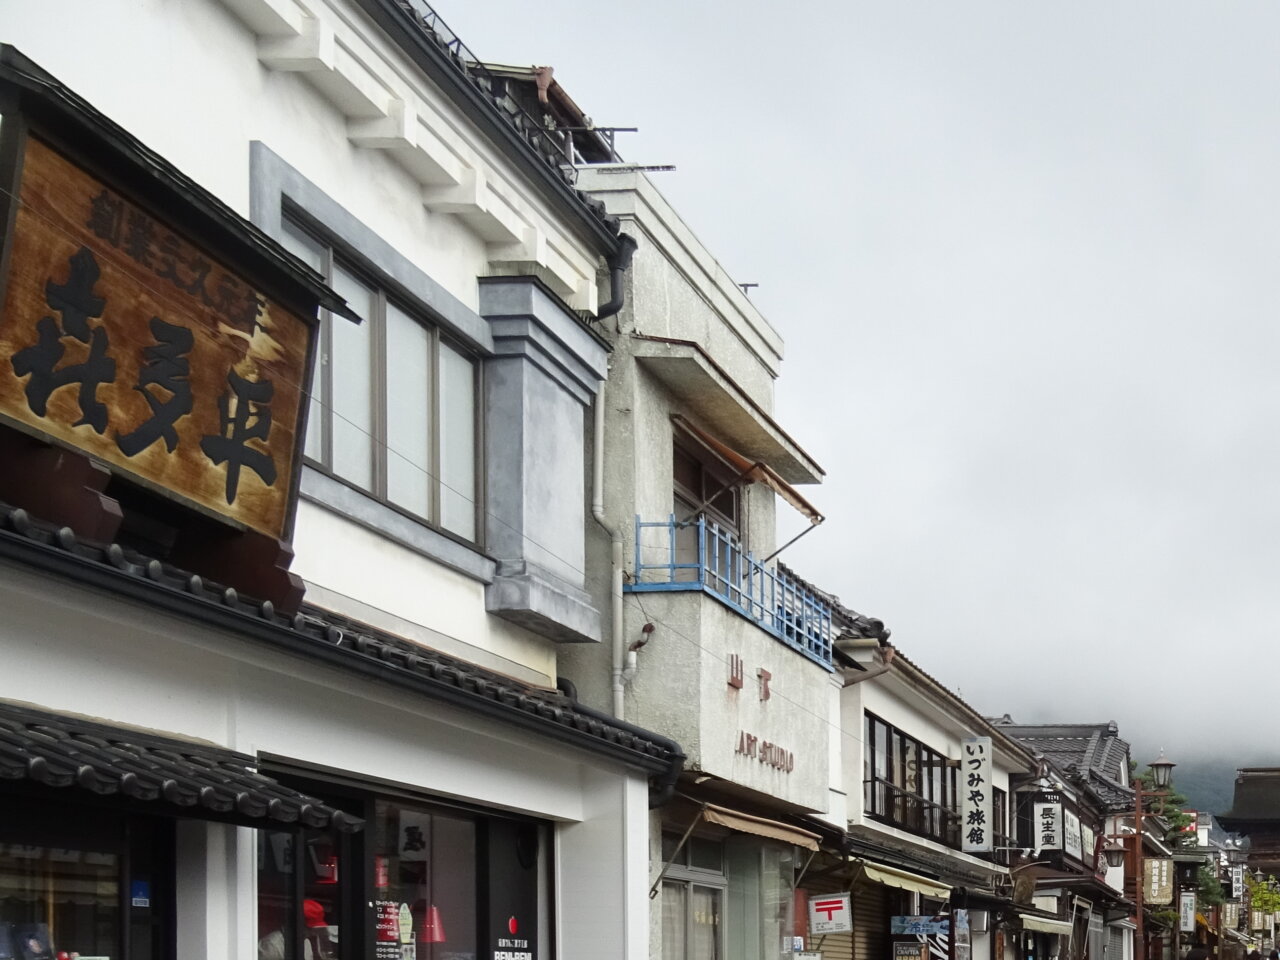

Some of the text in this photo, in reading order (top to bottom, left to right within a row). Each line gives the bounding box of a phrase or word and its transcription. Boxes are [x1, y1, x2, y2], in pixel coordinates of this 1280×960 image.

[735, 729, 794, 773] ART STUDIO
[966, 744, 986, 845] いづみや旅館
[1040, 807, 1057, 846] 長生堂
